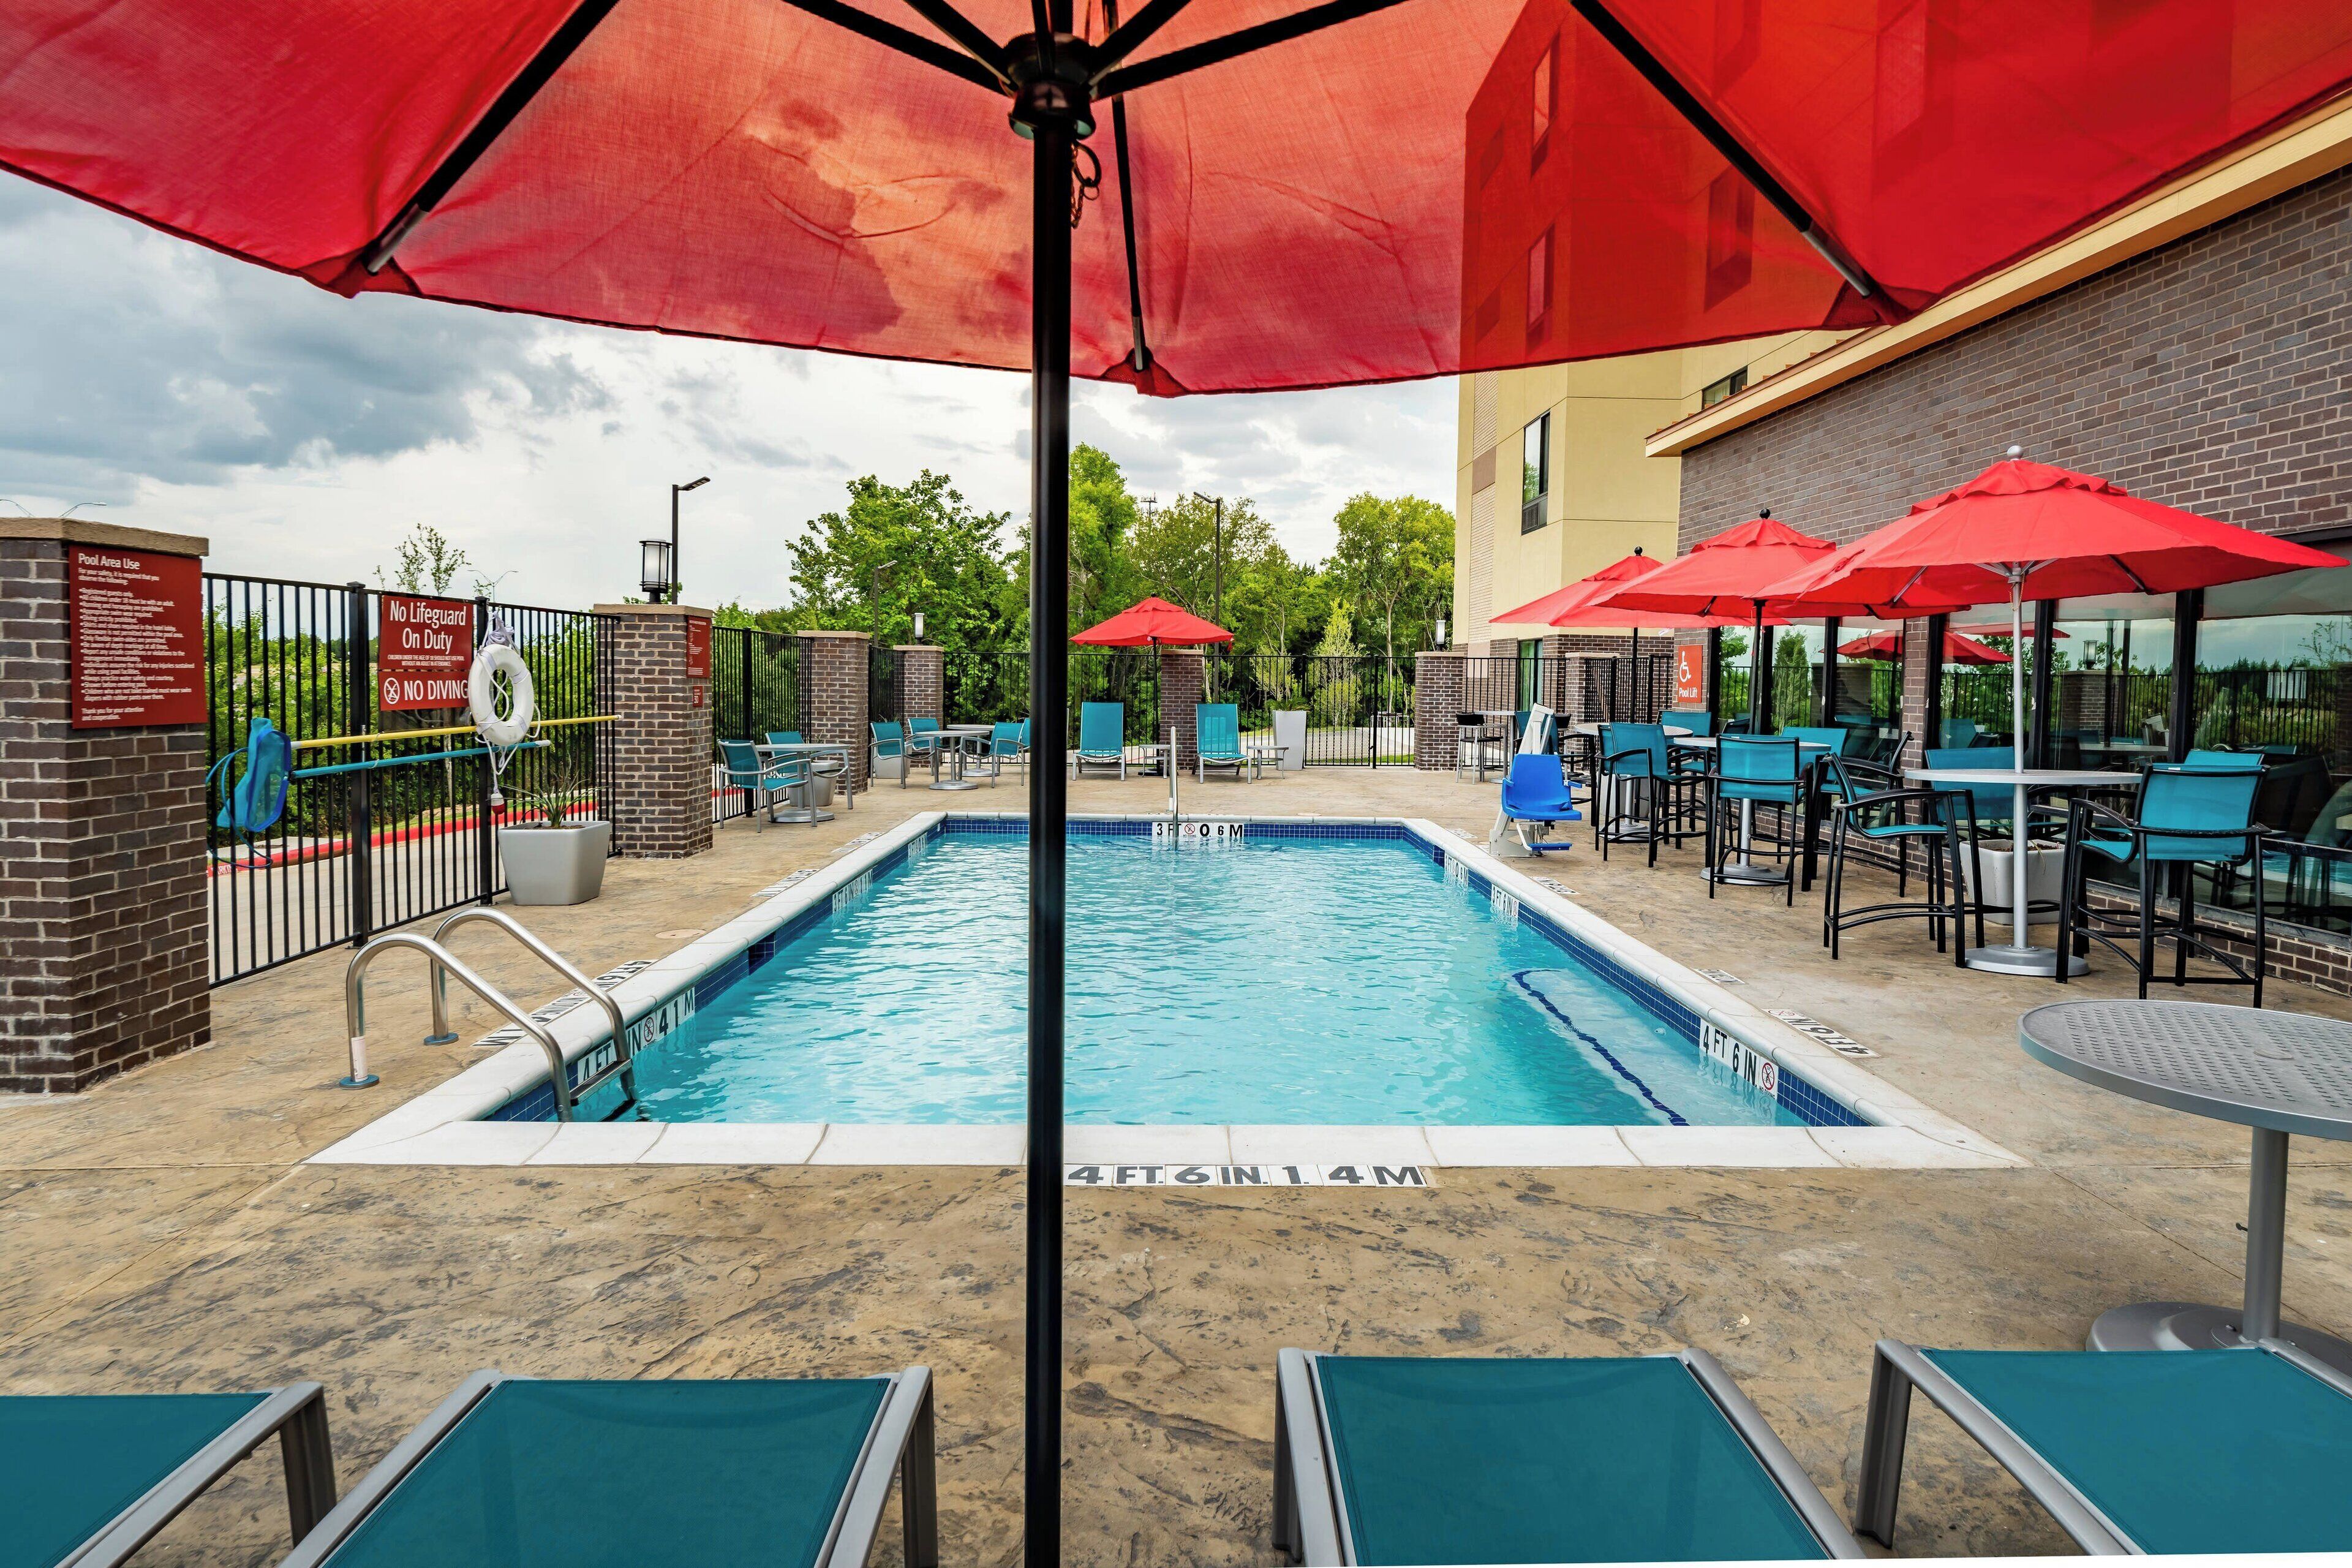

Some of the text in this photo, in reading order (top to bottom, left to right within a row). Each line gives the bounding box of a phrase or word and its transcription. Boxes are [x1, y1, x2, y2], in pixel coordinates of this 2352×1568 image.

[78, 553, 140, 570] Pool Area Use
[390, 600, 466, 629] No Lifeguard
[402, 627, 453, 655] On Duty
[404, 680, 468, 701] NO DIVING
[1679, 687, 1689, 698] Pool
[1157, 823, 1163, 835] 3
[1230, 824, 1243, 837] M
[659, 1007, 668, 1036] 4
[685, 989, 693, 1016] M
[1703, 1025, 1709, 1054] 4
[1714, 1028, 1727, 1058] FT
[1733, 1042, 1740, 1072] 6
[1068, 1166, 1104, 1184] 4
[1116, 1166, 1164, 1184] FT.
[1174, 1166, 1210, 1184] 6
[1220, 1166, 1268, 1185] IN.
[1372, 1166, 1423, 1185] M
